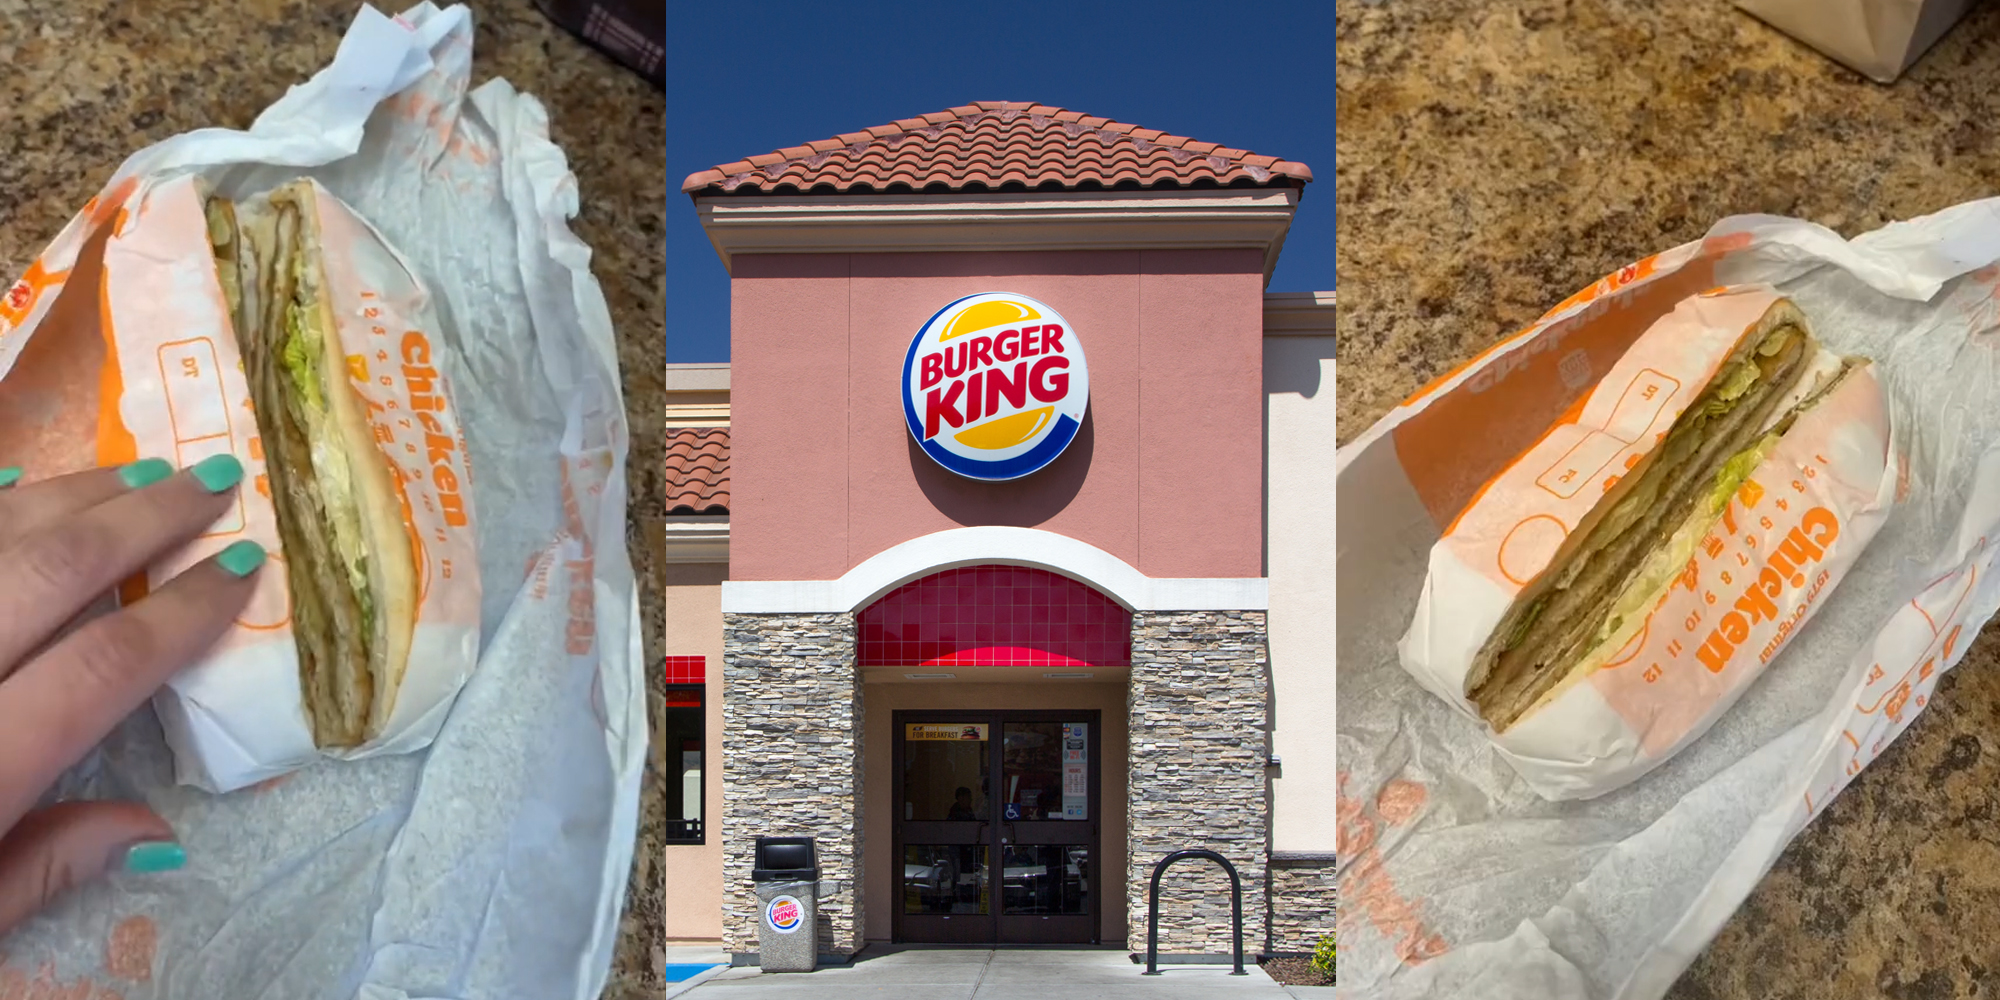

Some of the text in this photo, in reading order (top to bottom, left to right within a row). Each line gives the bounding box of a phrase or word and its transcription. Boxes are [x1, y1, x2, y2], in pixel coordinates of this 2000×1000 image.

[363, 307, 379, 318] 2
[376, 349, 388, 362] 4
[920, 323, 1065, 391] BURGER
[181, 357, 199, 378] DT
[379, 375, 393, 387] 5
[924, 355, 1071, 440] KING
[1641, 384, 1659, 401] DT
[386, 400, 399, 410] 6
[397, 418, 411, 429] 7
[400, 330, 468, 527] Chicken
[405, 442, 417, 454] 8
[412, 467, 422, 480] 9
[1558, 468, 1578, 483] FC
[435, 526, 448, 542] 11
[441, 557, 452, 580] 12
[1642, 454, 1828, 683] 1 2 3 4 5 6 7 8 9 10 11 12
[1695, 506, 1839, 673] Chicken
[1759, 604, 1807, 664] Original
[773, 904, 797, 916] BURGER
[774, 909, 798, 924] KING
